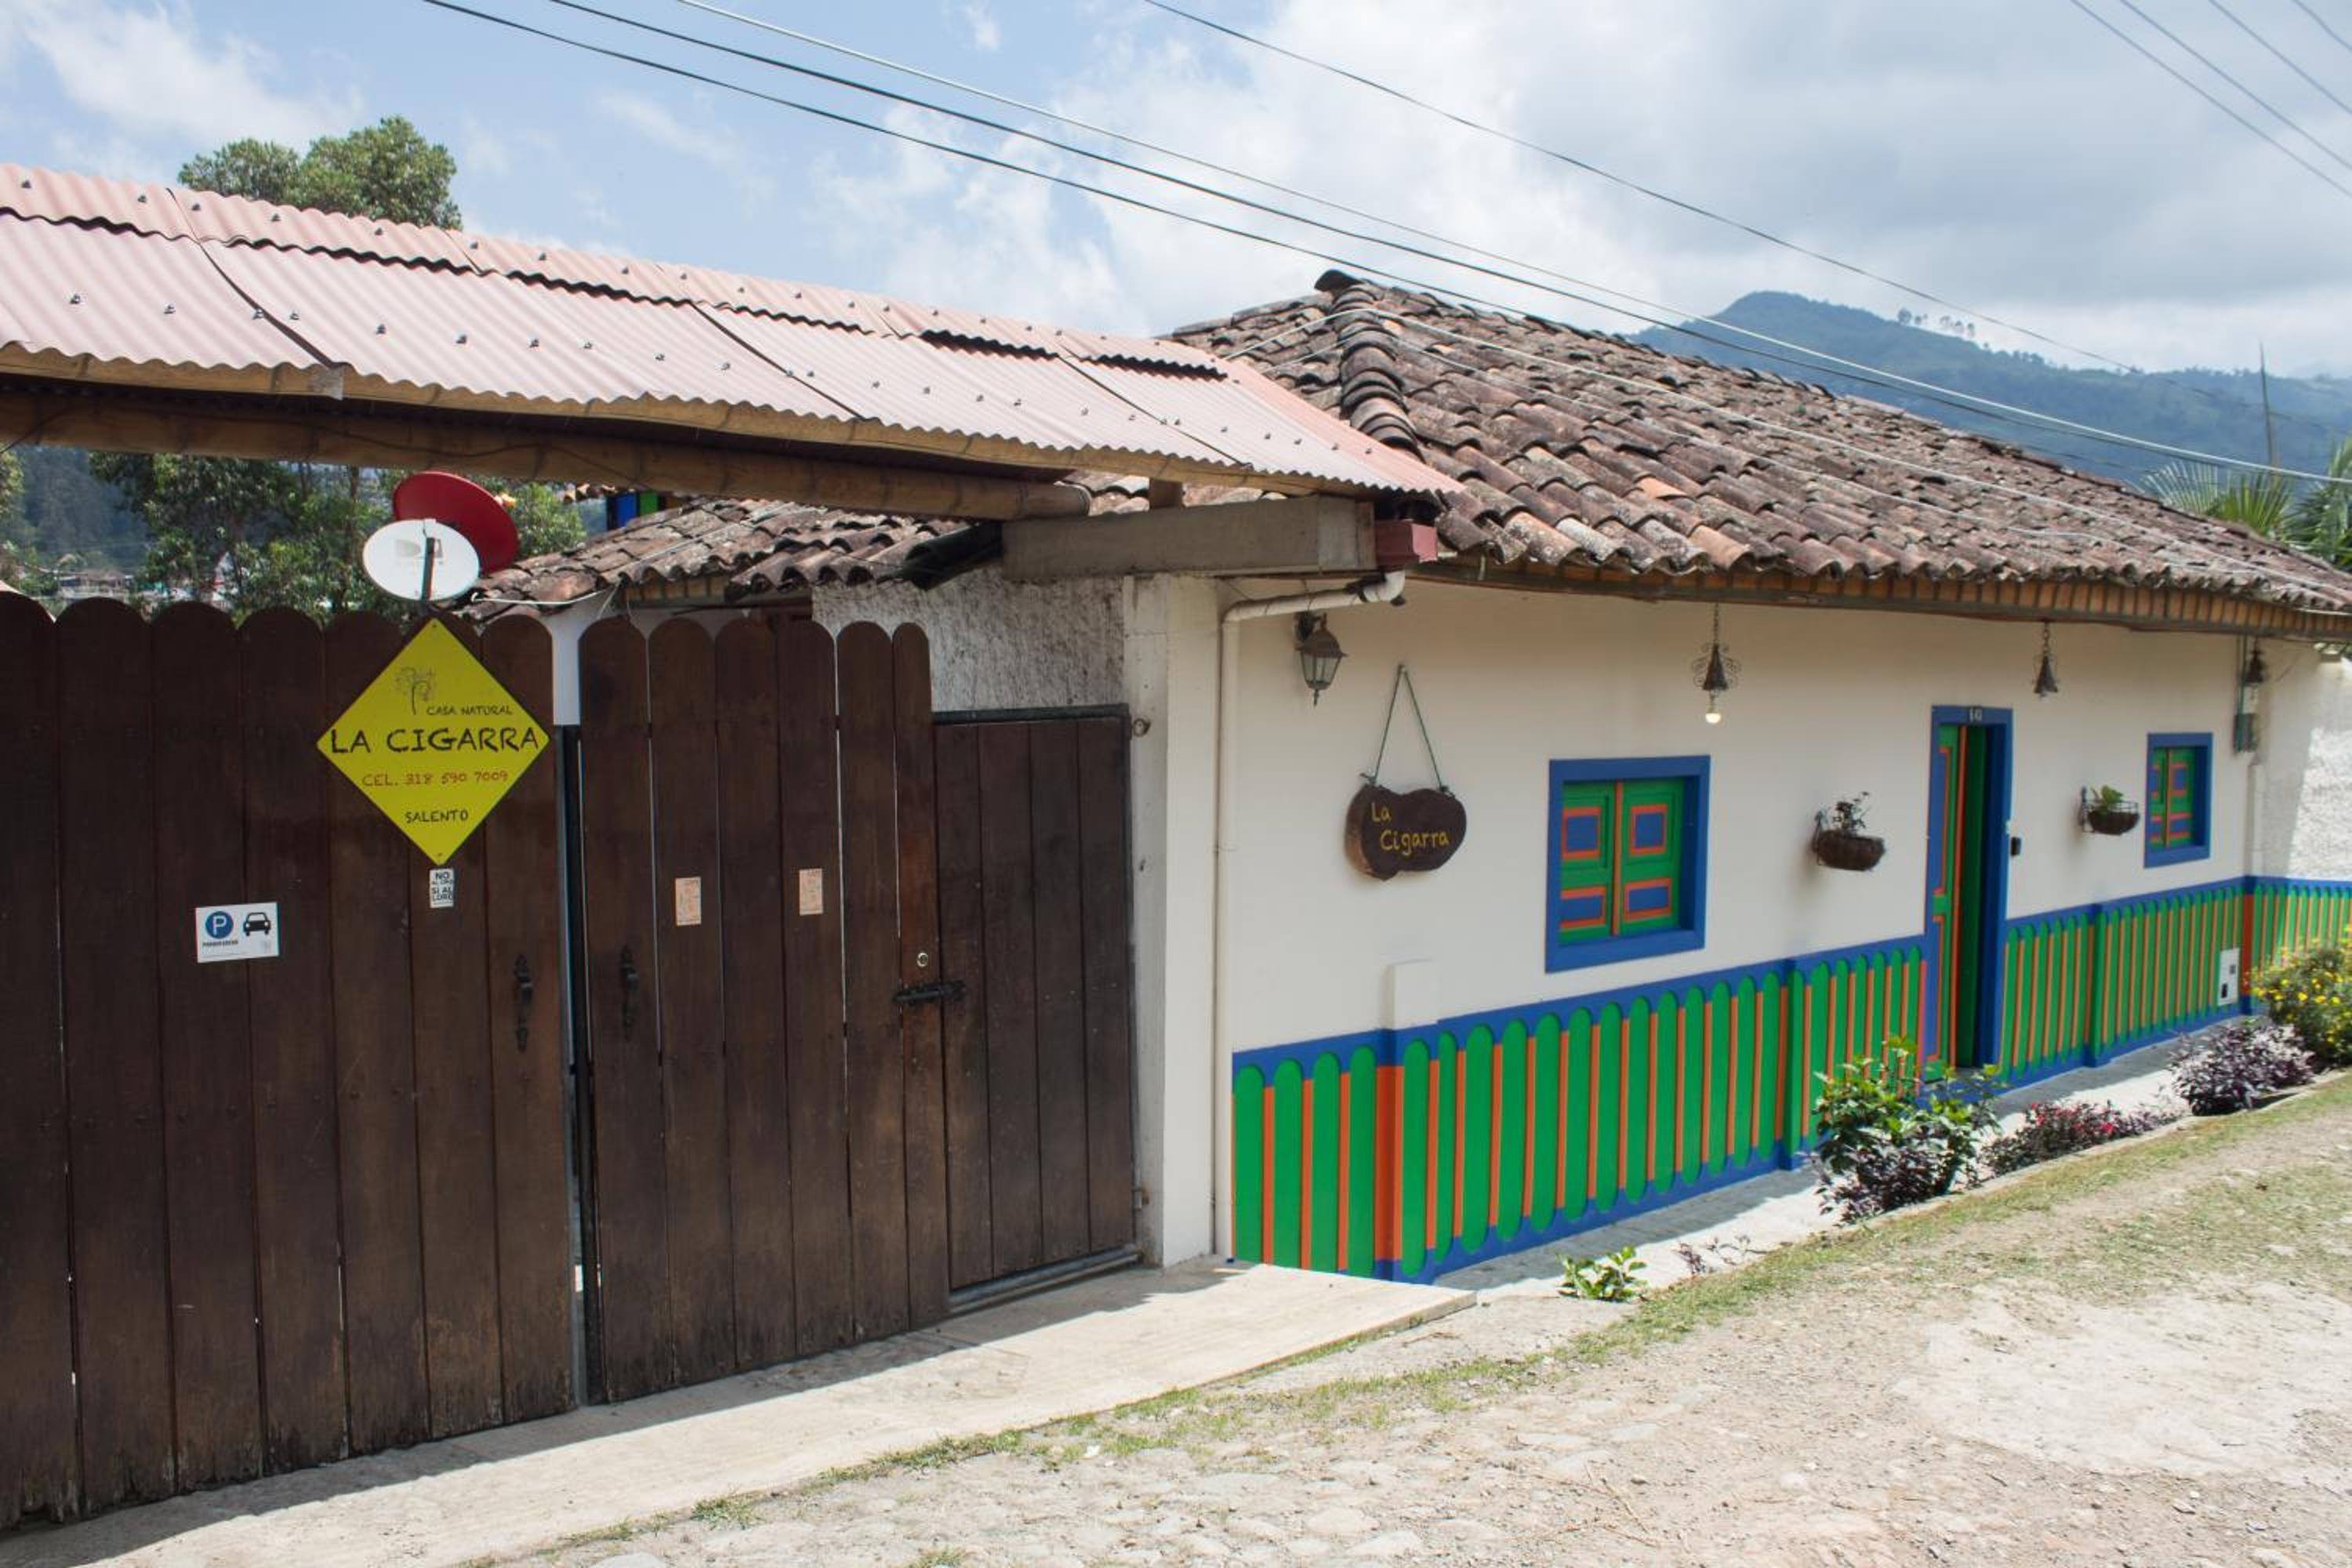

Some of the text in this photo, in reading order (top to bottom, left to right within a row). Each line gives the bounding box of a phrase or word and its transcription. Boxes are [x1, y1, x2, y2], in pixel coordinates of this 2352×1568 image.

[426, 705, 513, 716] CASA NATURAL
[330, 727, 539, 753] LA CIGARRA
[361, 773, 398, 787] CEL.
[405, 809, 469, 823] SALENTO
[1371, 802, 1392, 822] La
[1381, 829, 1450, 856] Cigarra
[212, 915, 227, 935] P
